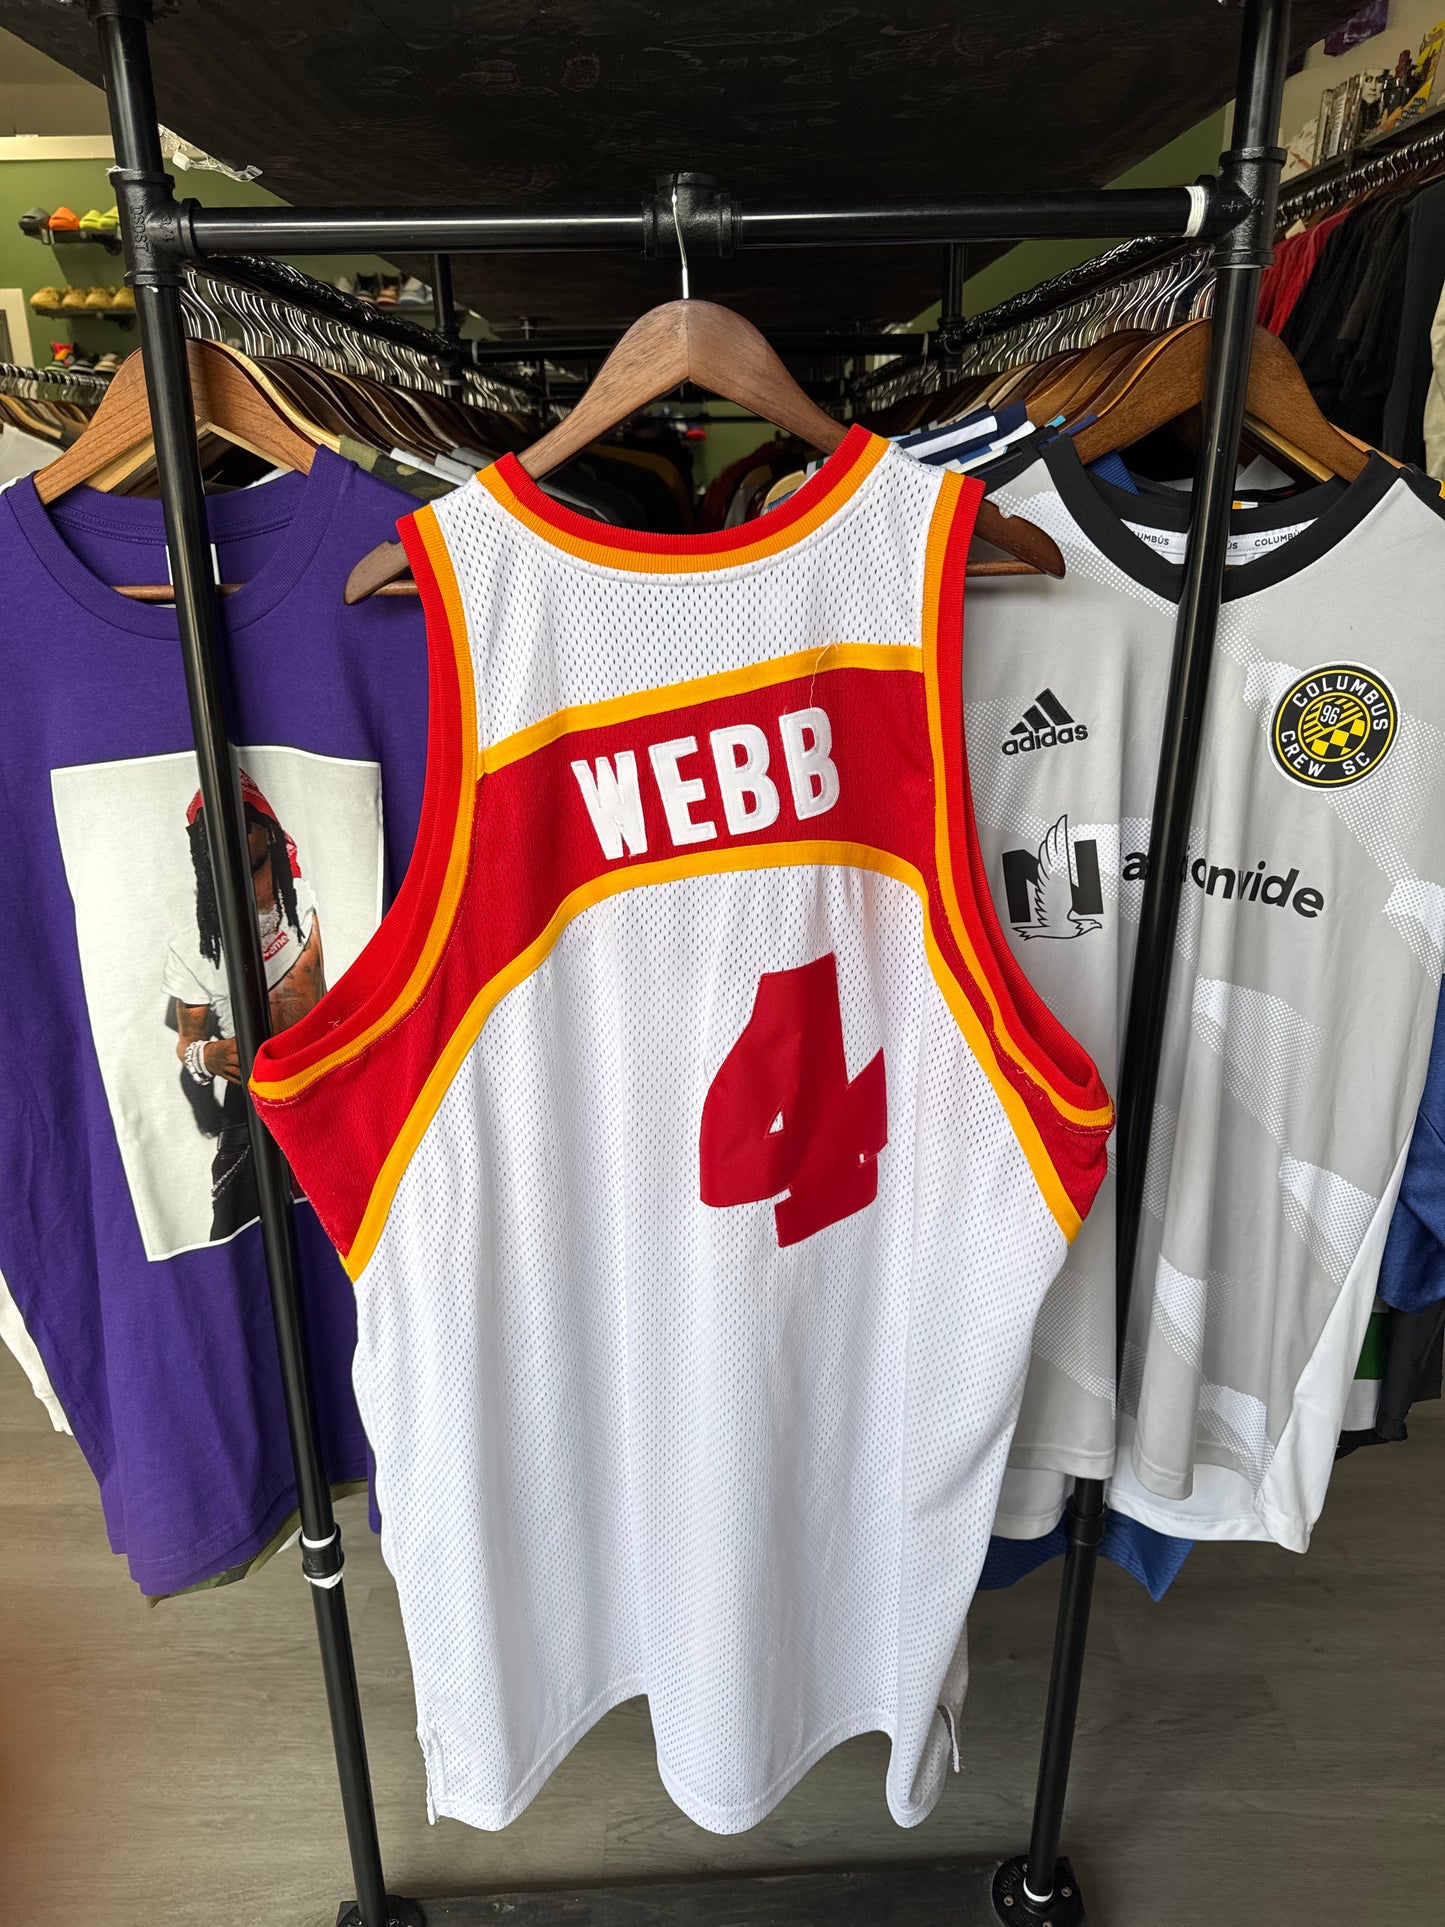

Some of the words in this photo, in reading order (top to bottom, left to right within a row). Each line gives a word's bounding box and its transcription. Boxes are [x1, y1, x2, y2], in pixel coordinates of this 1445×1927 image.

[1292, 675, 1389, 731] COLUMBUS
[1320, 704, 1341, 725] 96
[1001, 723, 1089, 756] adidas
[1281, 730, 1326, 777] CREW
[1342, 751, 1370, 776] SC
[570, 707, 840, 861] WEBB
[700, 951, 889, 1249] 4
